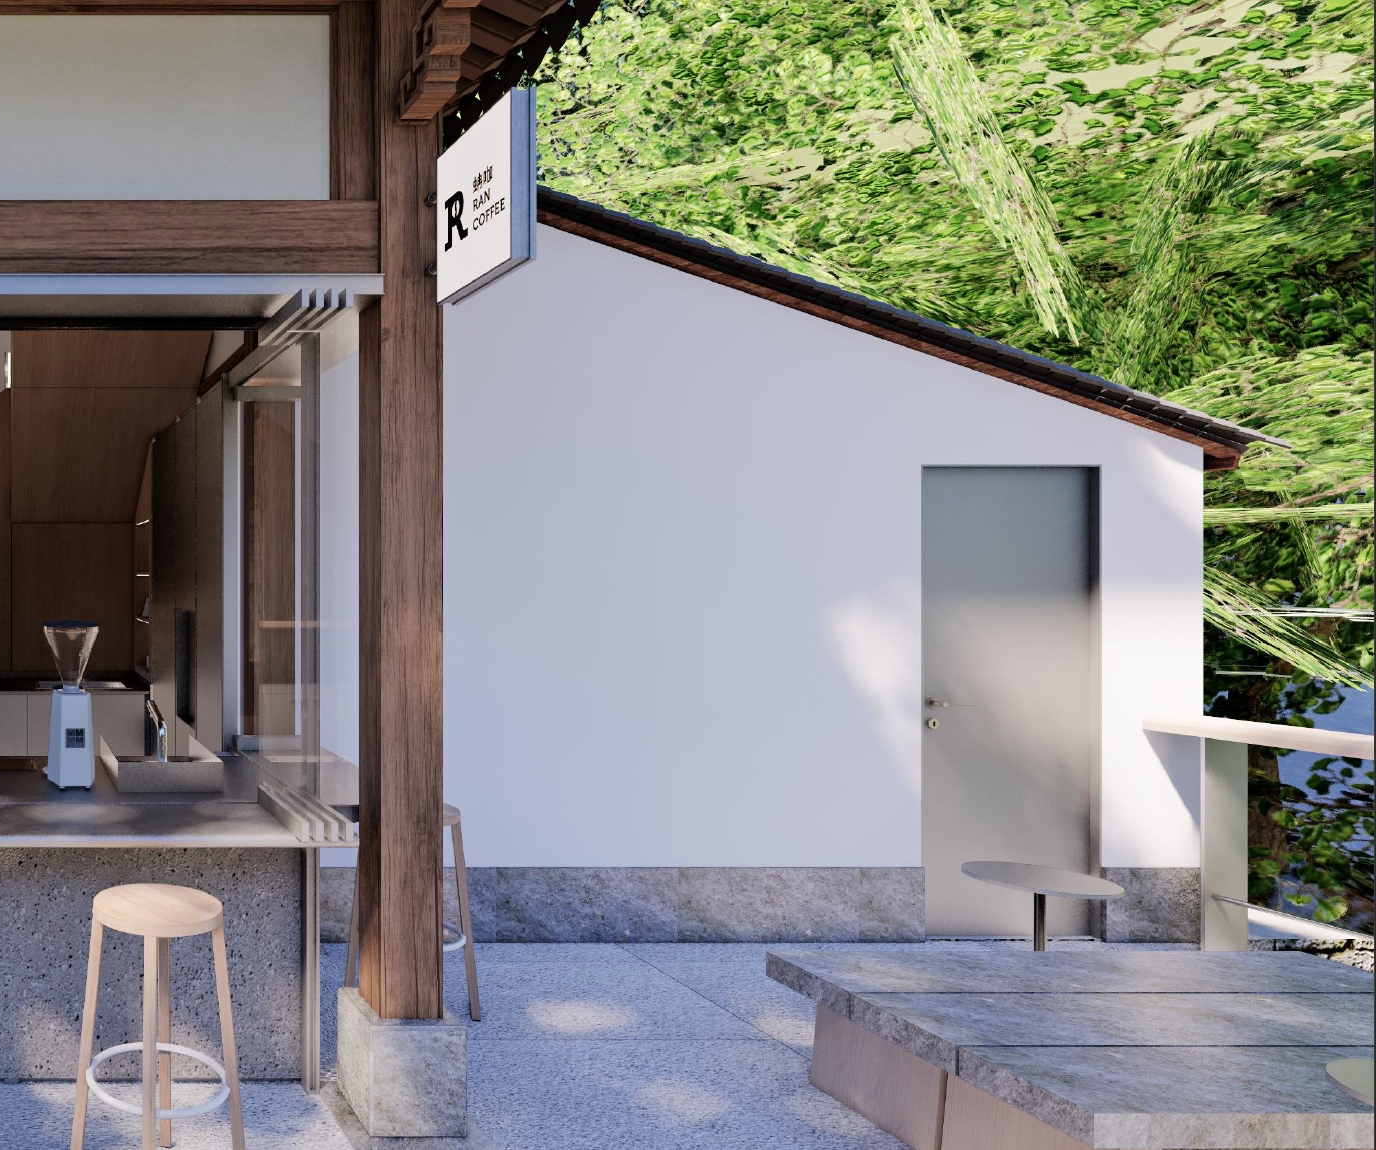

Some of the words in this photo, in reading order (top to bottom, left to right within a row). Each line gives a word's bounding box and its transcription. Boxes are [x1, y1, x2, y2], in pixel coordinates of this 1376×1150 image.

[473, 188, 490, 211] RAN
[473, 197, 505, 230] COFFEE
[444, 190, 469, 252] R
